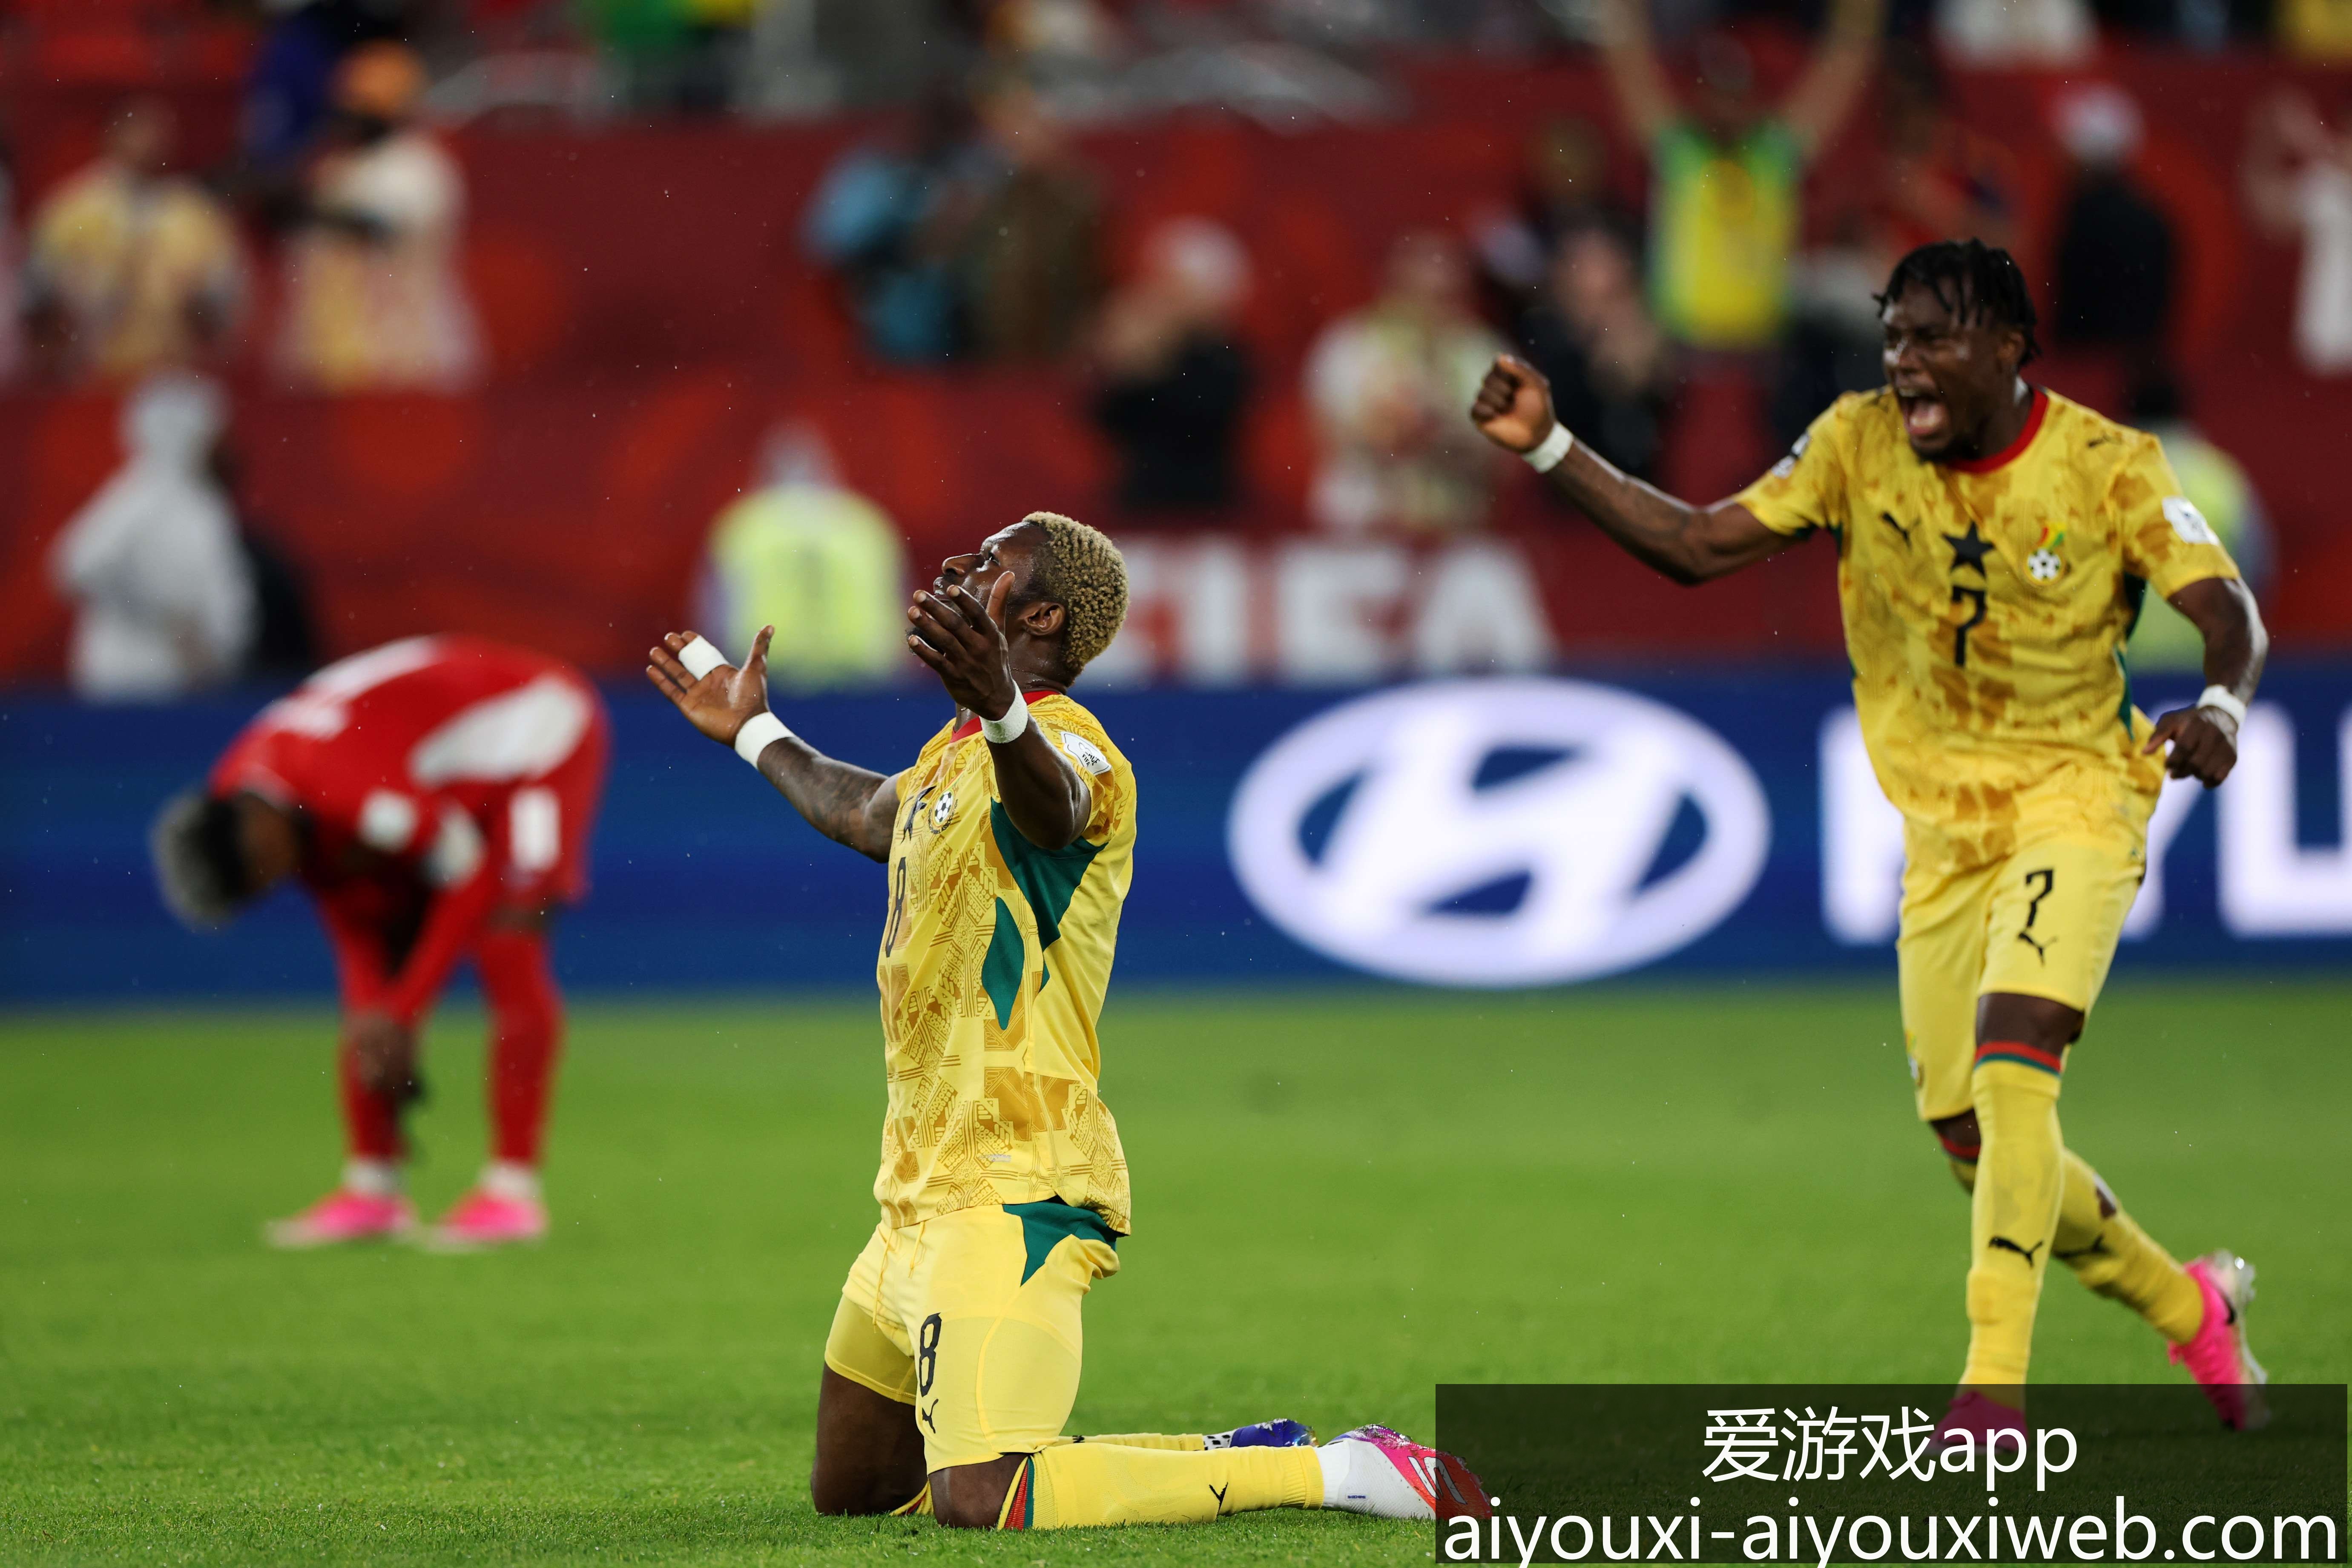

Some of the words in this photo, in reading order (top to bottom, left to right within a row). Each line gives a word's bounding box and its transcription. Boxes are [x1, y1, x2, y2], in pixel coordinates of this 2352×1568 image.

[1951, 585, 1986, 667] 7
[885, 856, 906, 958] 8
[2025, 868, 2053, 928] 7
[919, 1312, 942, 1398] 8
